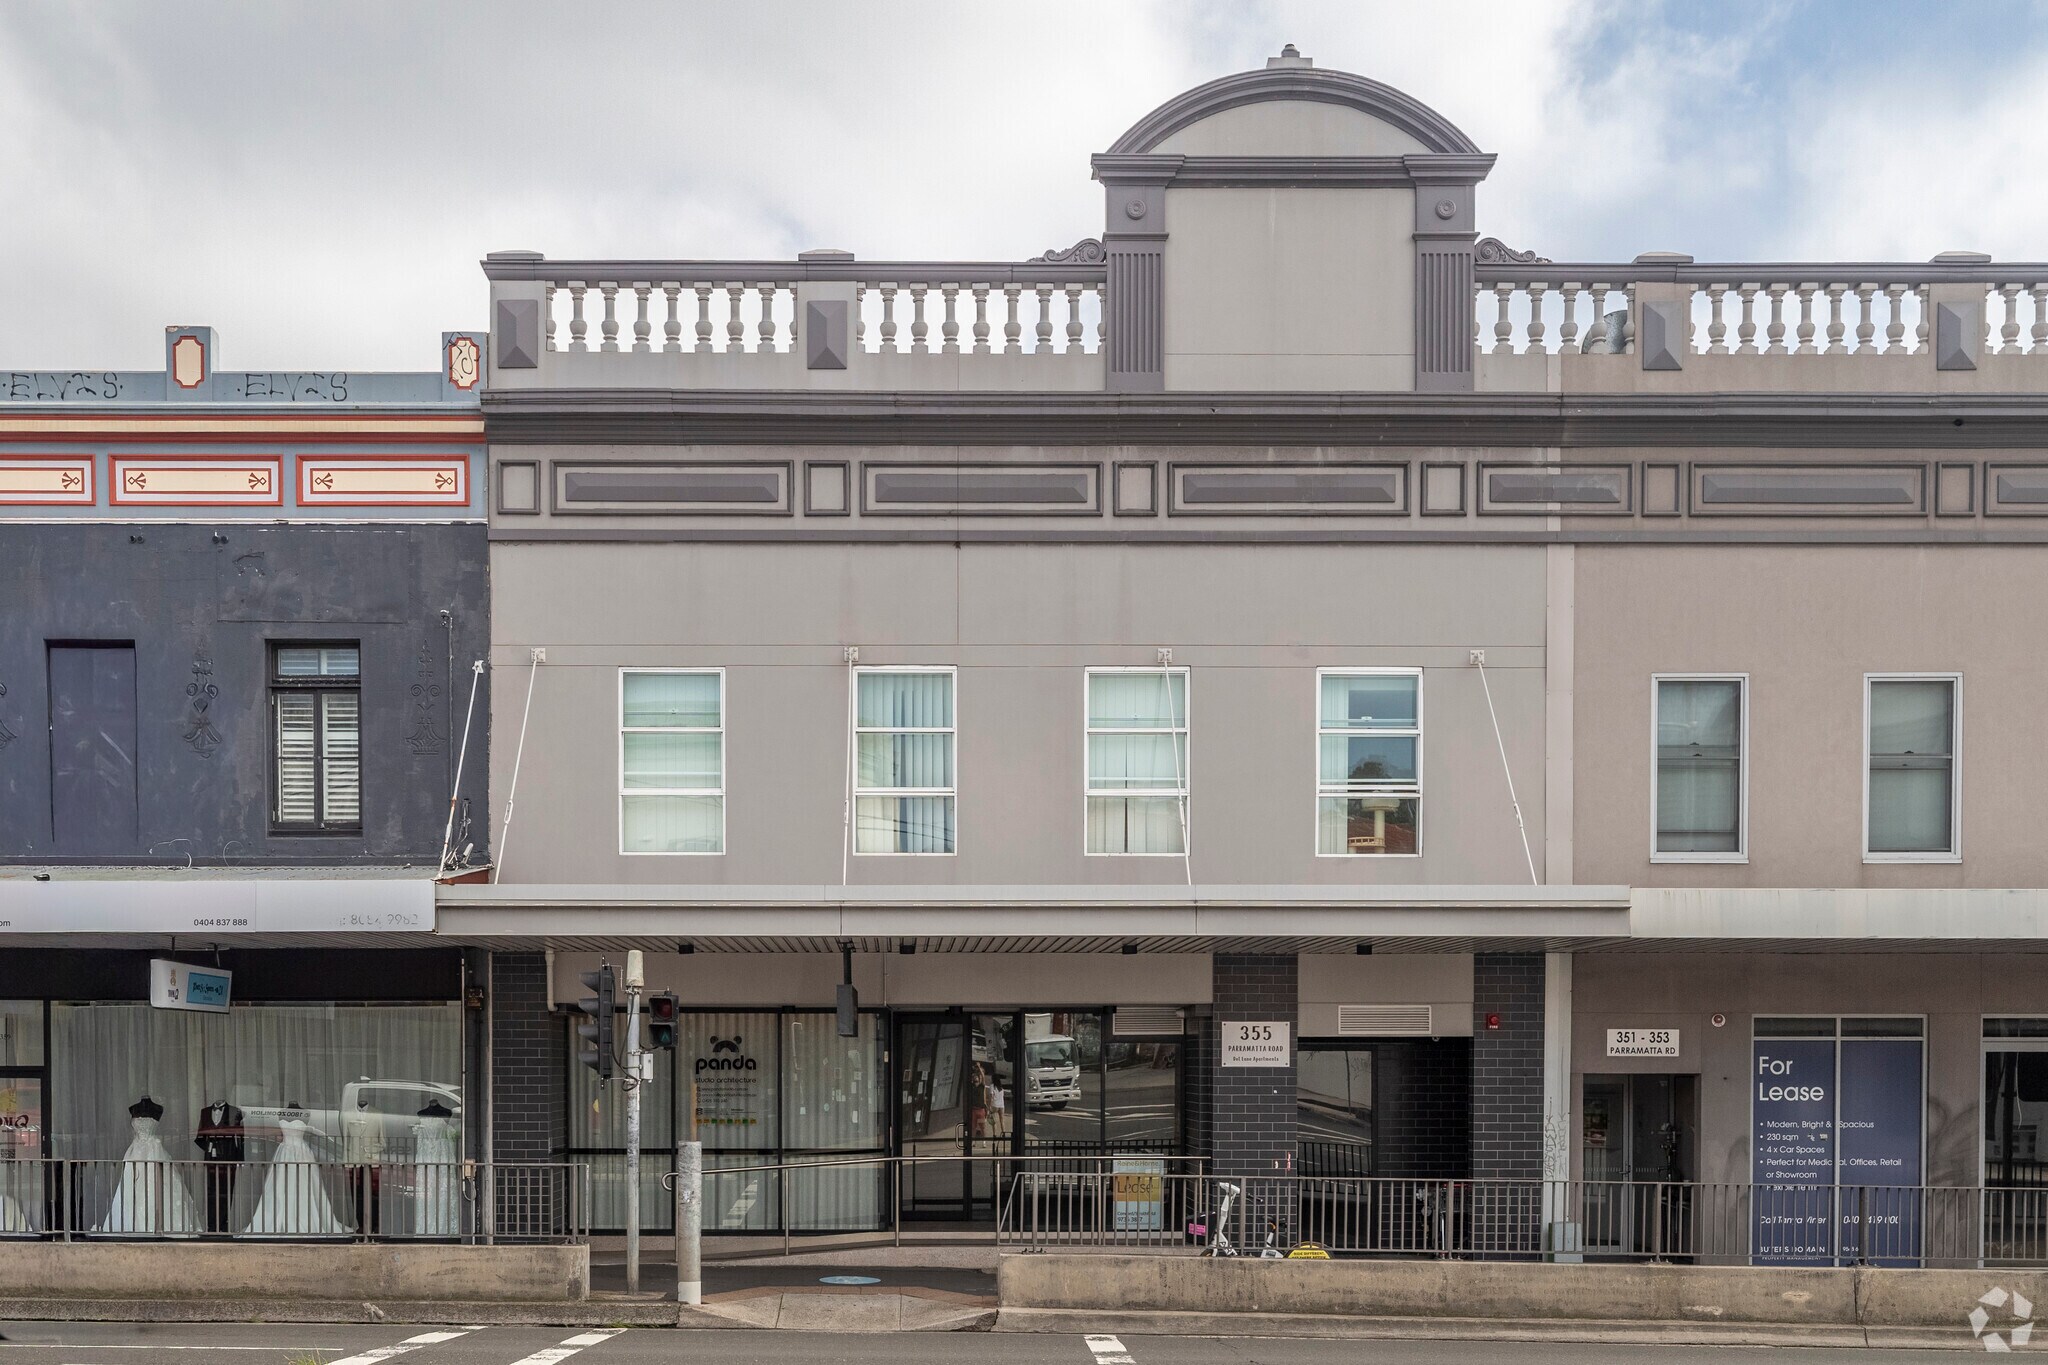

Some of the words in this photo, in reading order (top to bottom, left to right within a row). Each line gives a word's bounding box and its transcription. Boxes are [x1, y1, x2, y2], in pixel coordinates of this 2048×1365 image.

[193, 918, 214, 926] 0404
[216, 918, 231, 926] 837
[232, 918, 248, 926] 888
[1240, 1025, 1272, 1041] 355
[1616, 1031, 1637, 1044] 351
[1649, 1031, 1670, 1044] 353
[1610, 1047, 1663, 1055] PARRAMATTA
[1665, 1047, 1676, 1055] RD
[696, 1055, 757, 1075] panda
[1759, 1056, 1793, 1075] For
[1759, 1082, 1825, 1101] Lease
[1766, 1120, 1800, 1129] Modern,
[1801, 1120, 1824, 1130] Bright
[1825, 1120, 1832, 1129] &
[1839, 1120, 1875, 1130] Spacious
[1766, 1133, 1781, 1141] 230
[1782, 1134, 1799, 1142] sqm
[1796, 1146, 1825, 1155] Spaces
[1766, 1158, 1795, 1166] Perfect
[1796, 1158, 1807, 1166] for
[1880, 1158, 1902, 1166] Retail
[1775, 1171, 1817, 1179] Showroom
[1760, 1216, 1776, 1224] Cal
